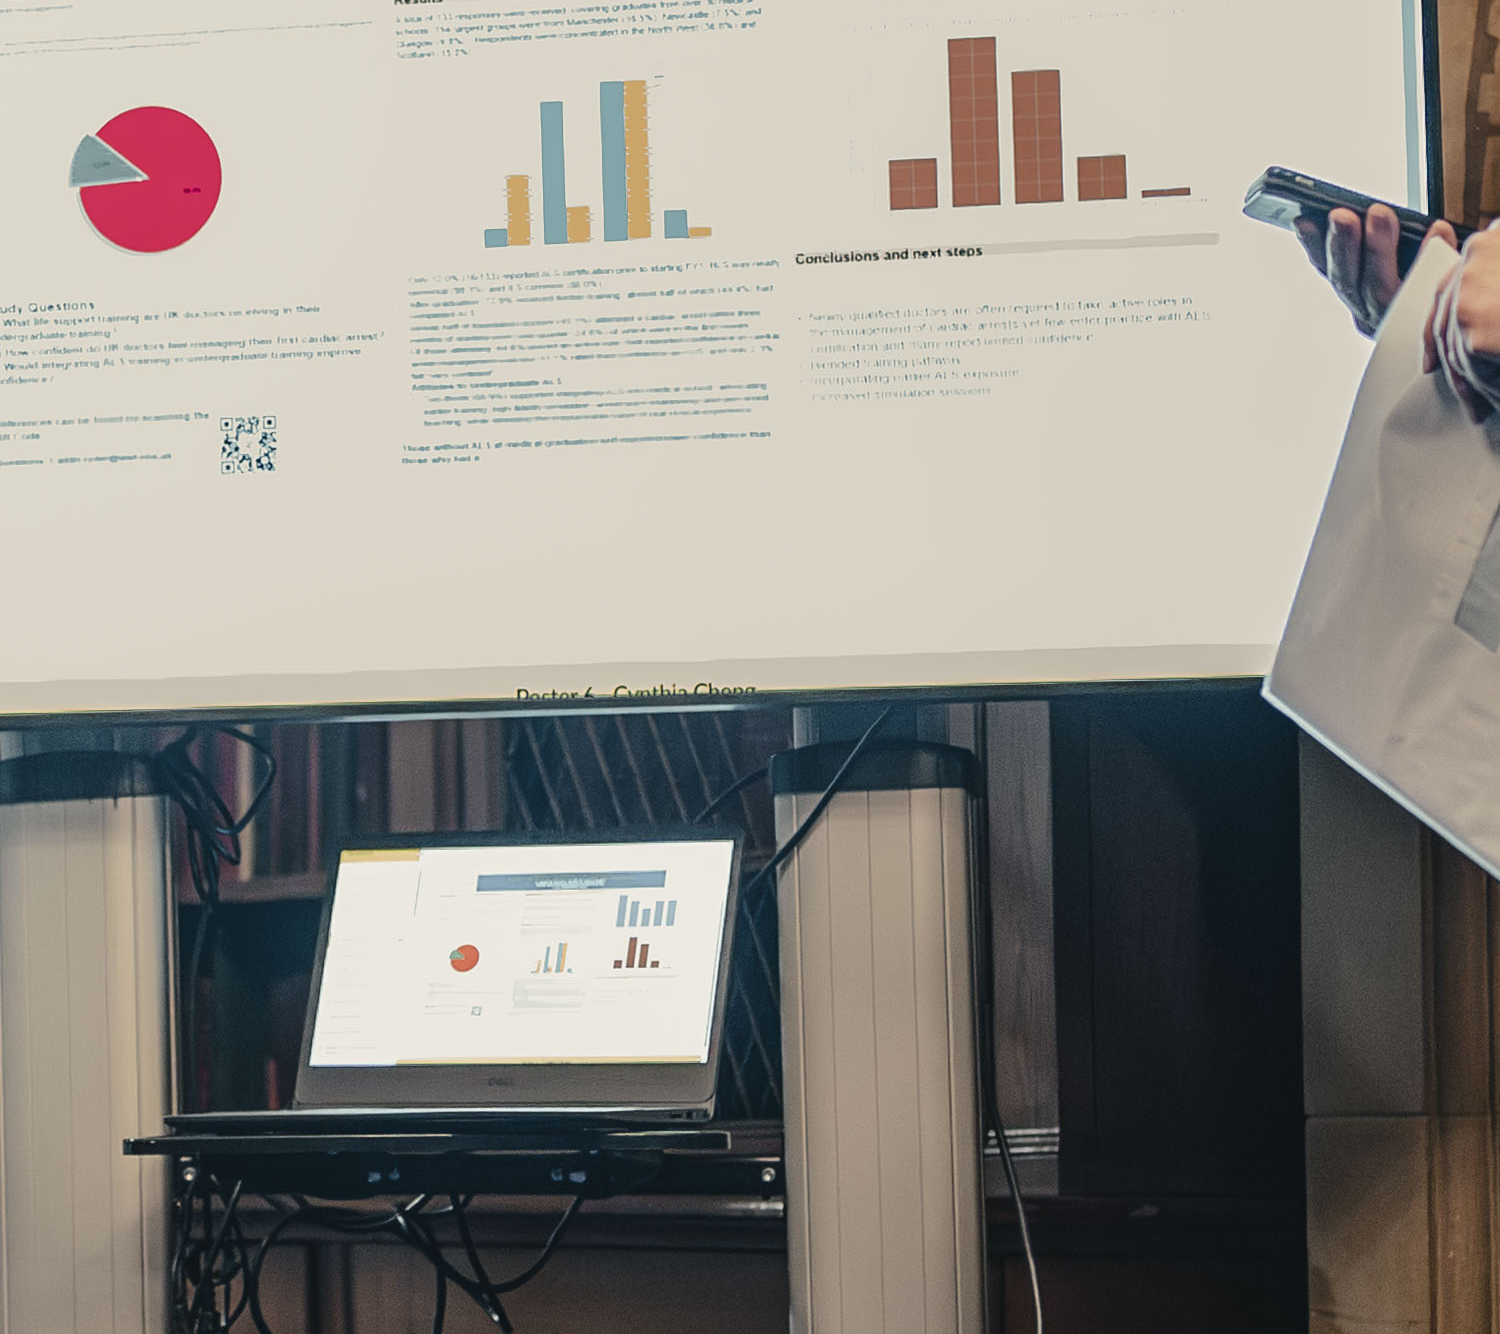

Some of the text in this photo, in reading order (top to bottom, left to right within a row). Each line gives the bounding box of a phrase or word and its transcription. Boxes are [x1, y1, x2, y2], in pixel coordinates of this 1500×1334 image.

[795, 245, 983, 265] Conclusions and next steps
[28, 302, 95, 313] Questions
